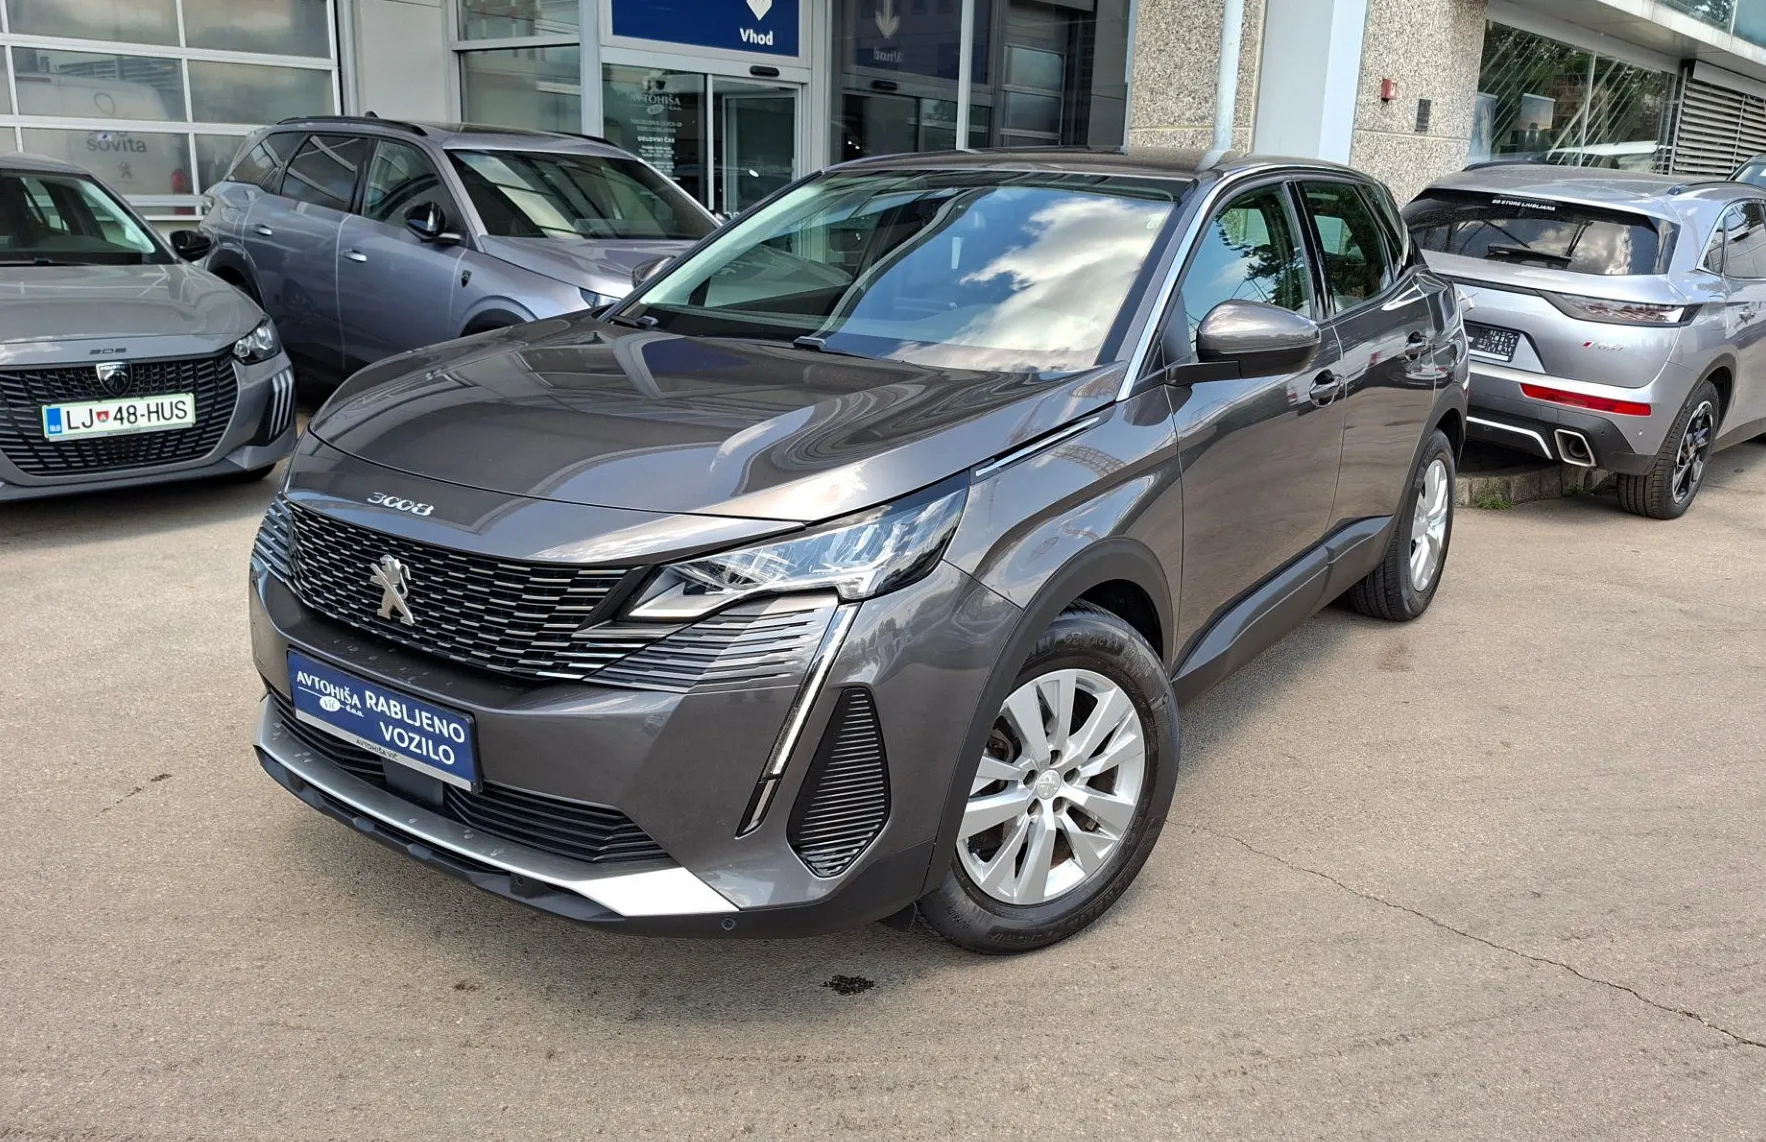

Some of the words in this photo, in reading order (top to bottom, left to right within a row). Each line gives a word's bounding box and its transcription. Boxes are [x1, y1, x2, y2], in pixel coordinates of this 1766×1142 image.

[739, 27, 773, 46] Vhod
[86, 138, 147, 153] sovita
[66, 408, 94, 430] LJ
[113, 400, 188, 425] 48-HUS
[367, 491, 434, 516] 3008
[297, 670, 362, 709] AVTOHIŠA
[364, 689, 465, 743] RABLJENO
[379, 721, 455, 765] VOZILO
